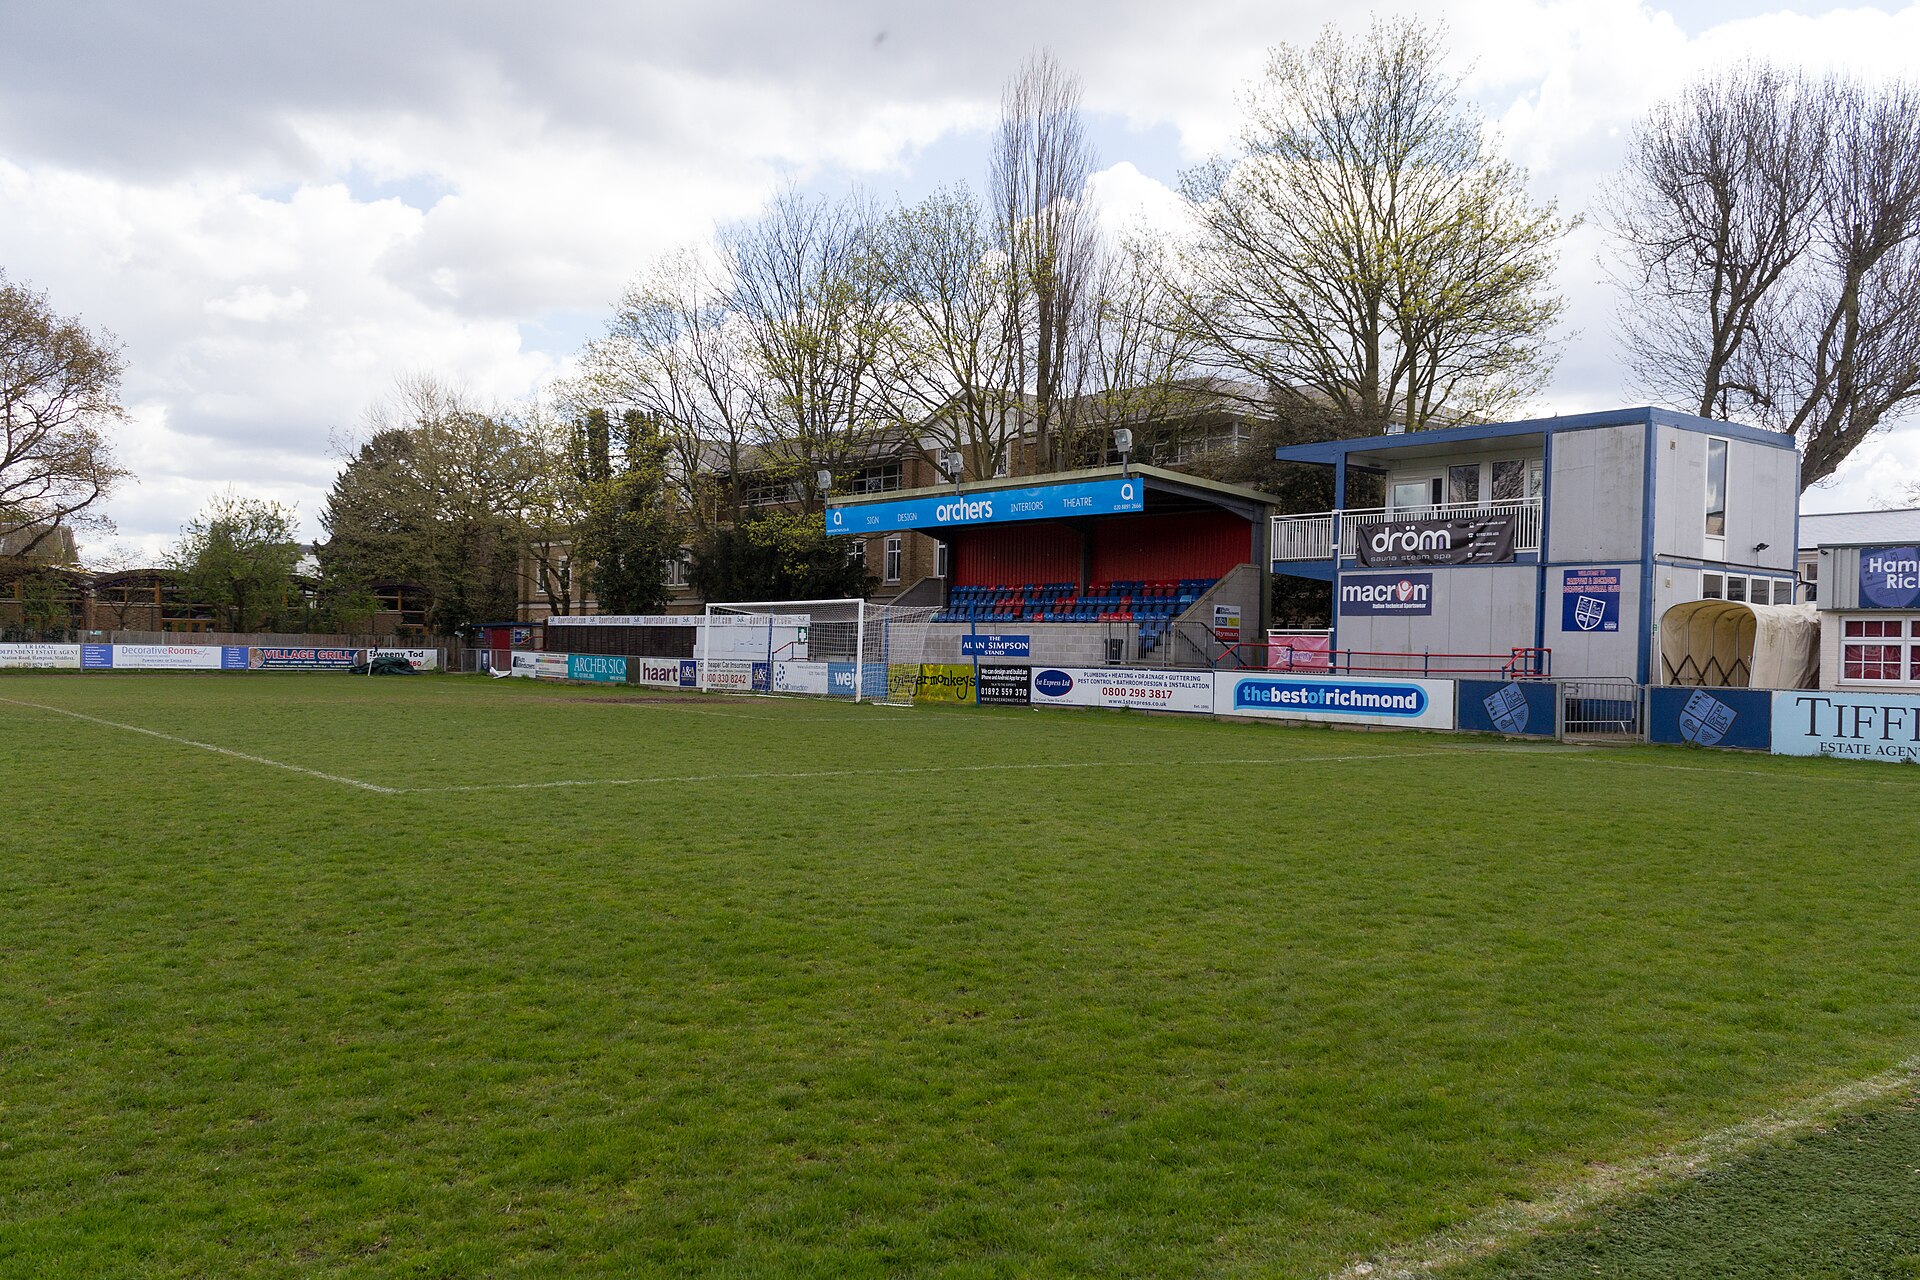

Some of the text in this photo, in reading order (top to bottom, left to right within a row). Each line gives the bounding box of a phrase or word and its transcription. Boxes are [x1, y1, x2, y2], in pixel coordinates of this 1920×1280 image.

[866, 496, 1092, 525] SIGN DESIGN archers INTERIORS THEATRE
[1371, 525, 1450, 553] dröm
[1434, 553, 1451, 561] spa
[1869, 558, 1920, 573] Ham
[1592, 576, 1617, 584] RICHMOND
[1342, 580, 1427, 602] macron
[1215, 630, 1239, 638] Ryman
[121, 646, 197, 655] DecorativeRooms
[264, 650, 352, 660] VILLAGE GRILL
[369, 650, 424, 658] Sweeny Tod
[574, 658, 607, 673] ARCHER
[708, 661, 721, 669] heaper
[642, 662, 678, 682] haart
[701, 673, 717, 683] 00
[717, 674, 729, 683] 330
[730, 675, 747, 684] 8242
[834, 668, 857, 690] wej
[1043, 678, 1061, 687] Express
[1062, 679, 1070, 687] Ltd
[980, 687, 1027, 697] 01892 559 370
[1102, 687, 1173, 699] 0800 298 3817
[1243, 685, 1417, 709] thebestofrichmond
[1108, 699, 1167, 707] www.1stexpress.co.uk
[1819, 742, 1871, 755] ESTATE
